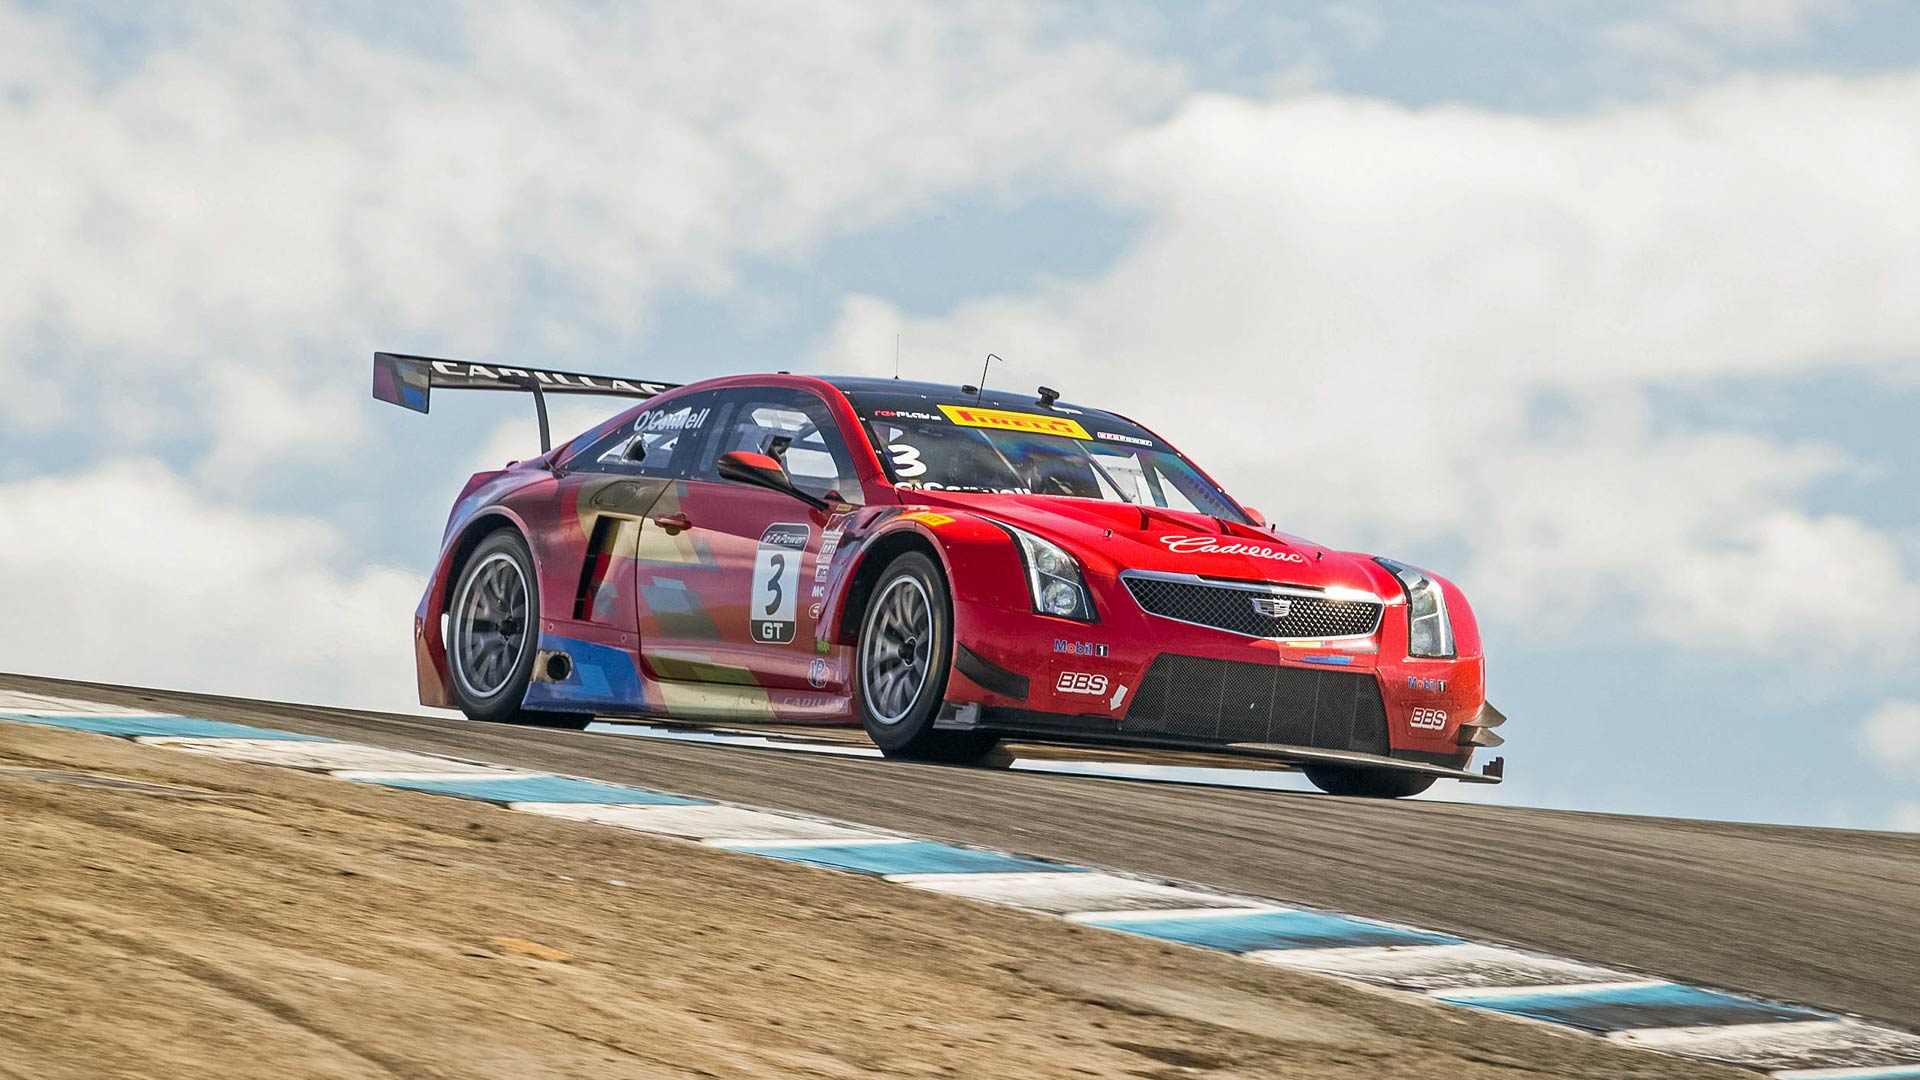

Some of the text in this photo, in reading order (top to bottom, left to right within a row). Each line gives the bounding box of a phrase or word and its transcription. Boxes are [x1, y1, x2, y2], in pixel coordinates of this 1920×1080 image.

[633, 406, 711, 431] O'Connell
[887, 444, 927, 477] 3
[1160, 535, 1304, 563] Cadillac
[765, 553, 785, 616] 3
[762, 622, 784, 639] GT
[1054, 639, 1093, 656] Mobil
[1056, 671, 1109, 695] BBS
[1410, 707, 1447, 730] BBS
